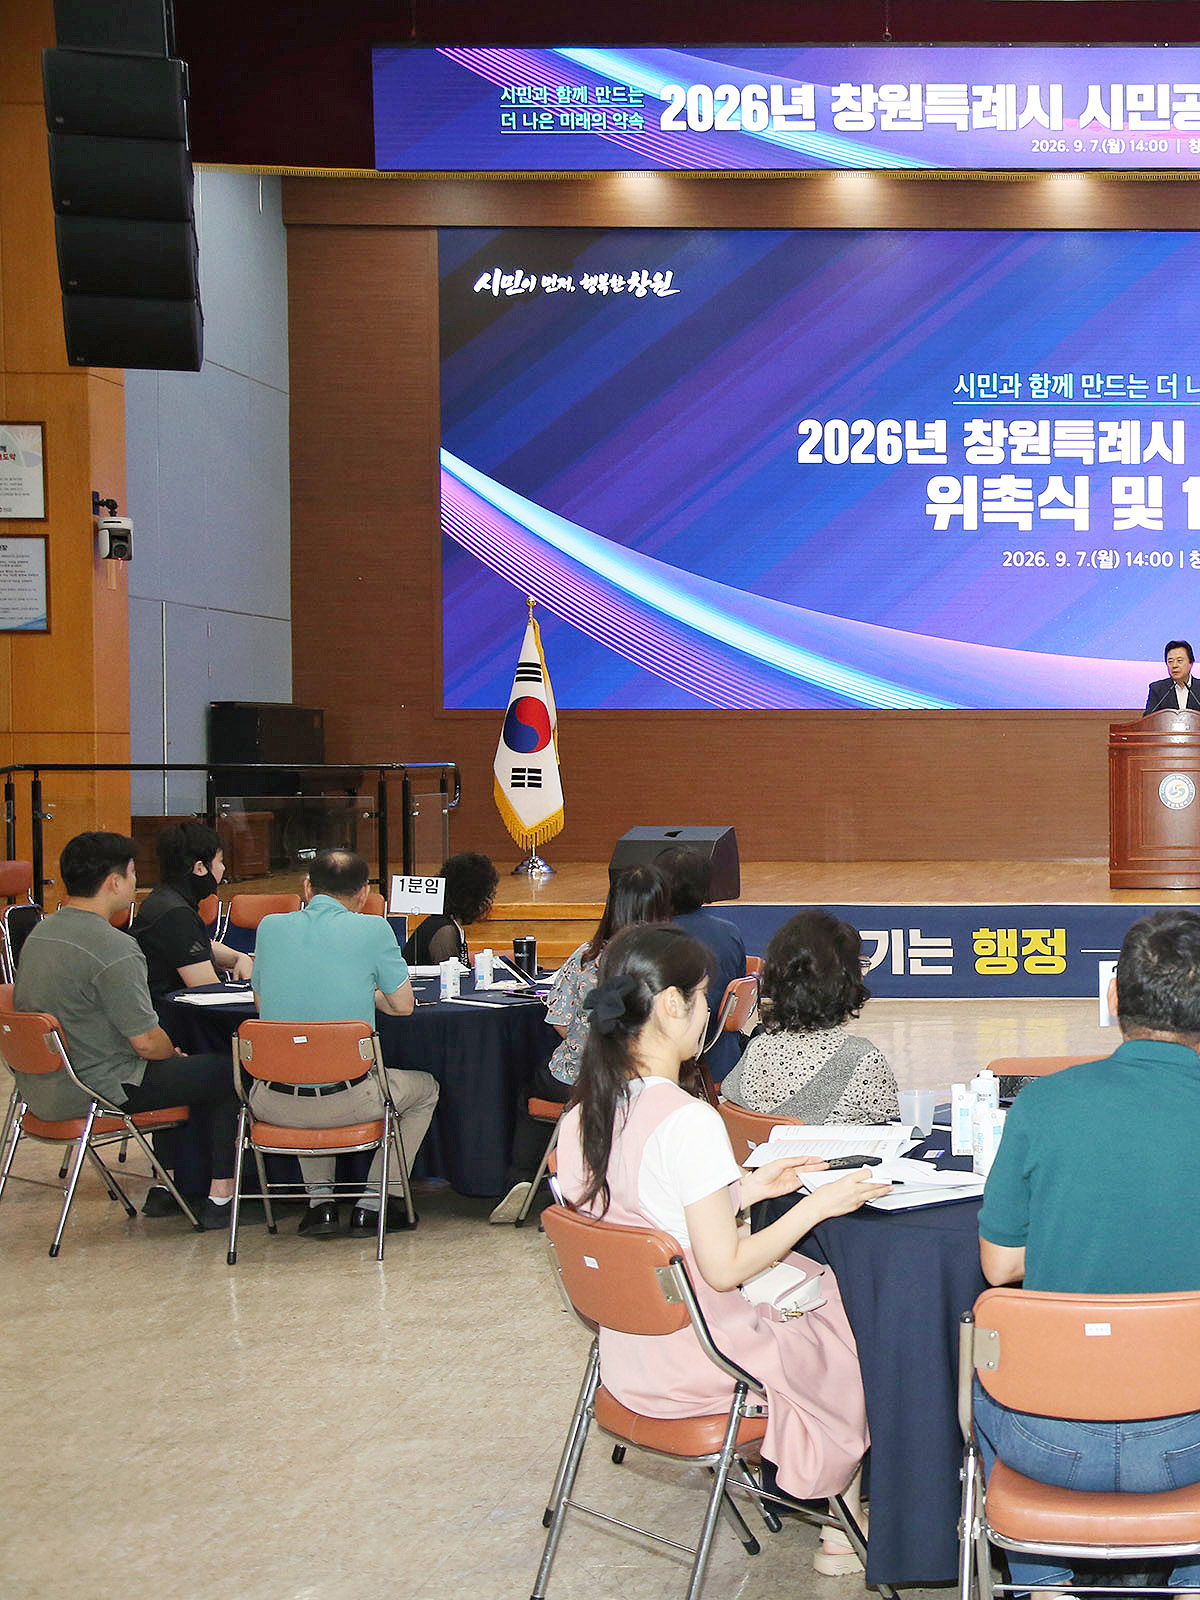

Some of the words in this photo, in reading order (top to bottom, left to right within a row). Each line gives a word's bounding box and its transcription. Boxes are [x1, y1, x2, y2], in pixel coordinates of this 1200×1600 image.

[500, 85, 550, 104] 시민과
[555, 85, 588, 104] 함께
[595, 85, 644, 104] 만드는
[660, 83, 812, 132] 2026년
[831, 83, 1064, 132] 창원특례시
[501, 112, 517, 130] 더
[522, 112, 555, 130] 나은
[559, 112, 607, 130] 미래의
[612, 112, 645, 130] 약속
[1031, 139, 1070, 153] 2026.
[1073, 139, 1086, 153] 9.
[1090, 138, 1126, 154] 7.(월)
[1130, 139, 1169, 153] 14:00
[473, 267, 538, 297] 시민이
[541, 273, 576, 294] 먼저,
[579, 271, 627, 296] 행복한
[626, 269, 681, 298] 창원
[953, 372, 1022, 400] 시민과
[1028, 372, 1074, 400] 함께
[1081, 372, 1150, 400] 만드는
[1156, 373, 1178, 400] 더
[797, 418, 948, 466] 2026년
[963, 418, 1186, 466] 창원특례시
[925, 474, 1091, 532] 위촉식
[1111, 474, 1164, 532] 및
[1002, 550, 1050, 568] 2026.
[1055, 551, 1071, 568] 9.
[1075, 549, 1121, 570] 7.(월)
[1125, 551, 1174, 568] 14:00
[399, 877, 440, 895] 1분임
[972, 927, 1068, 976] 행정
